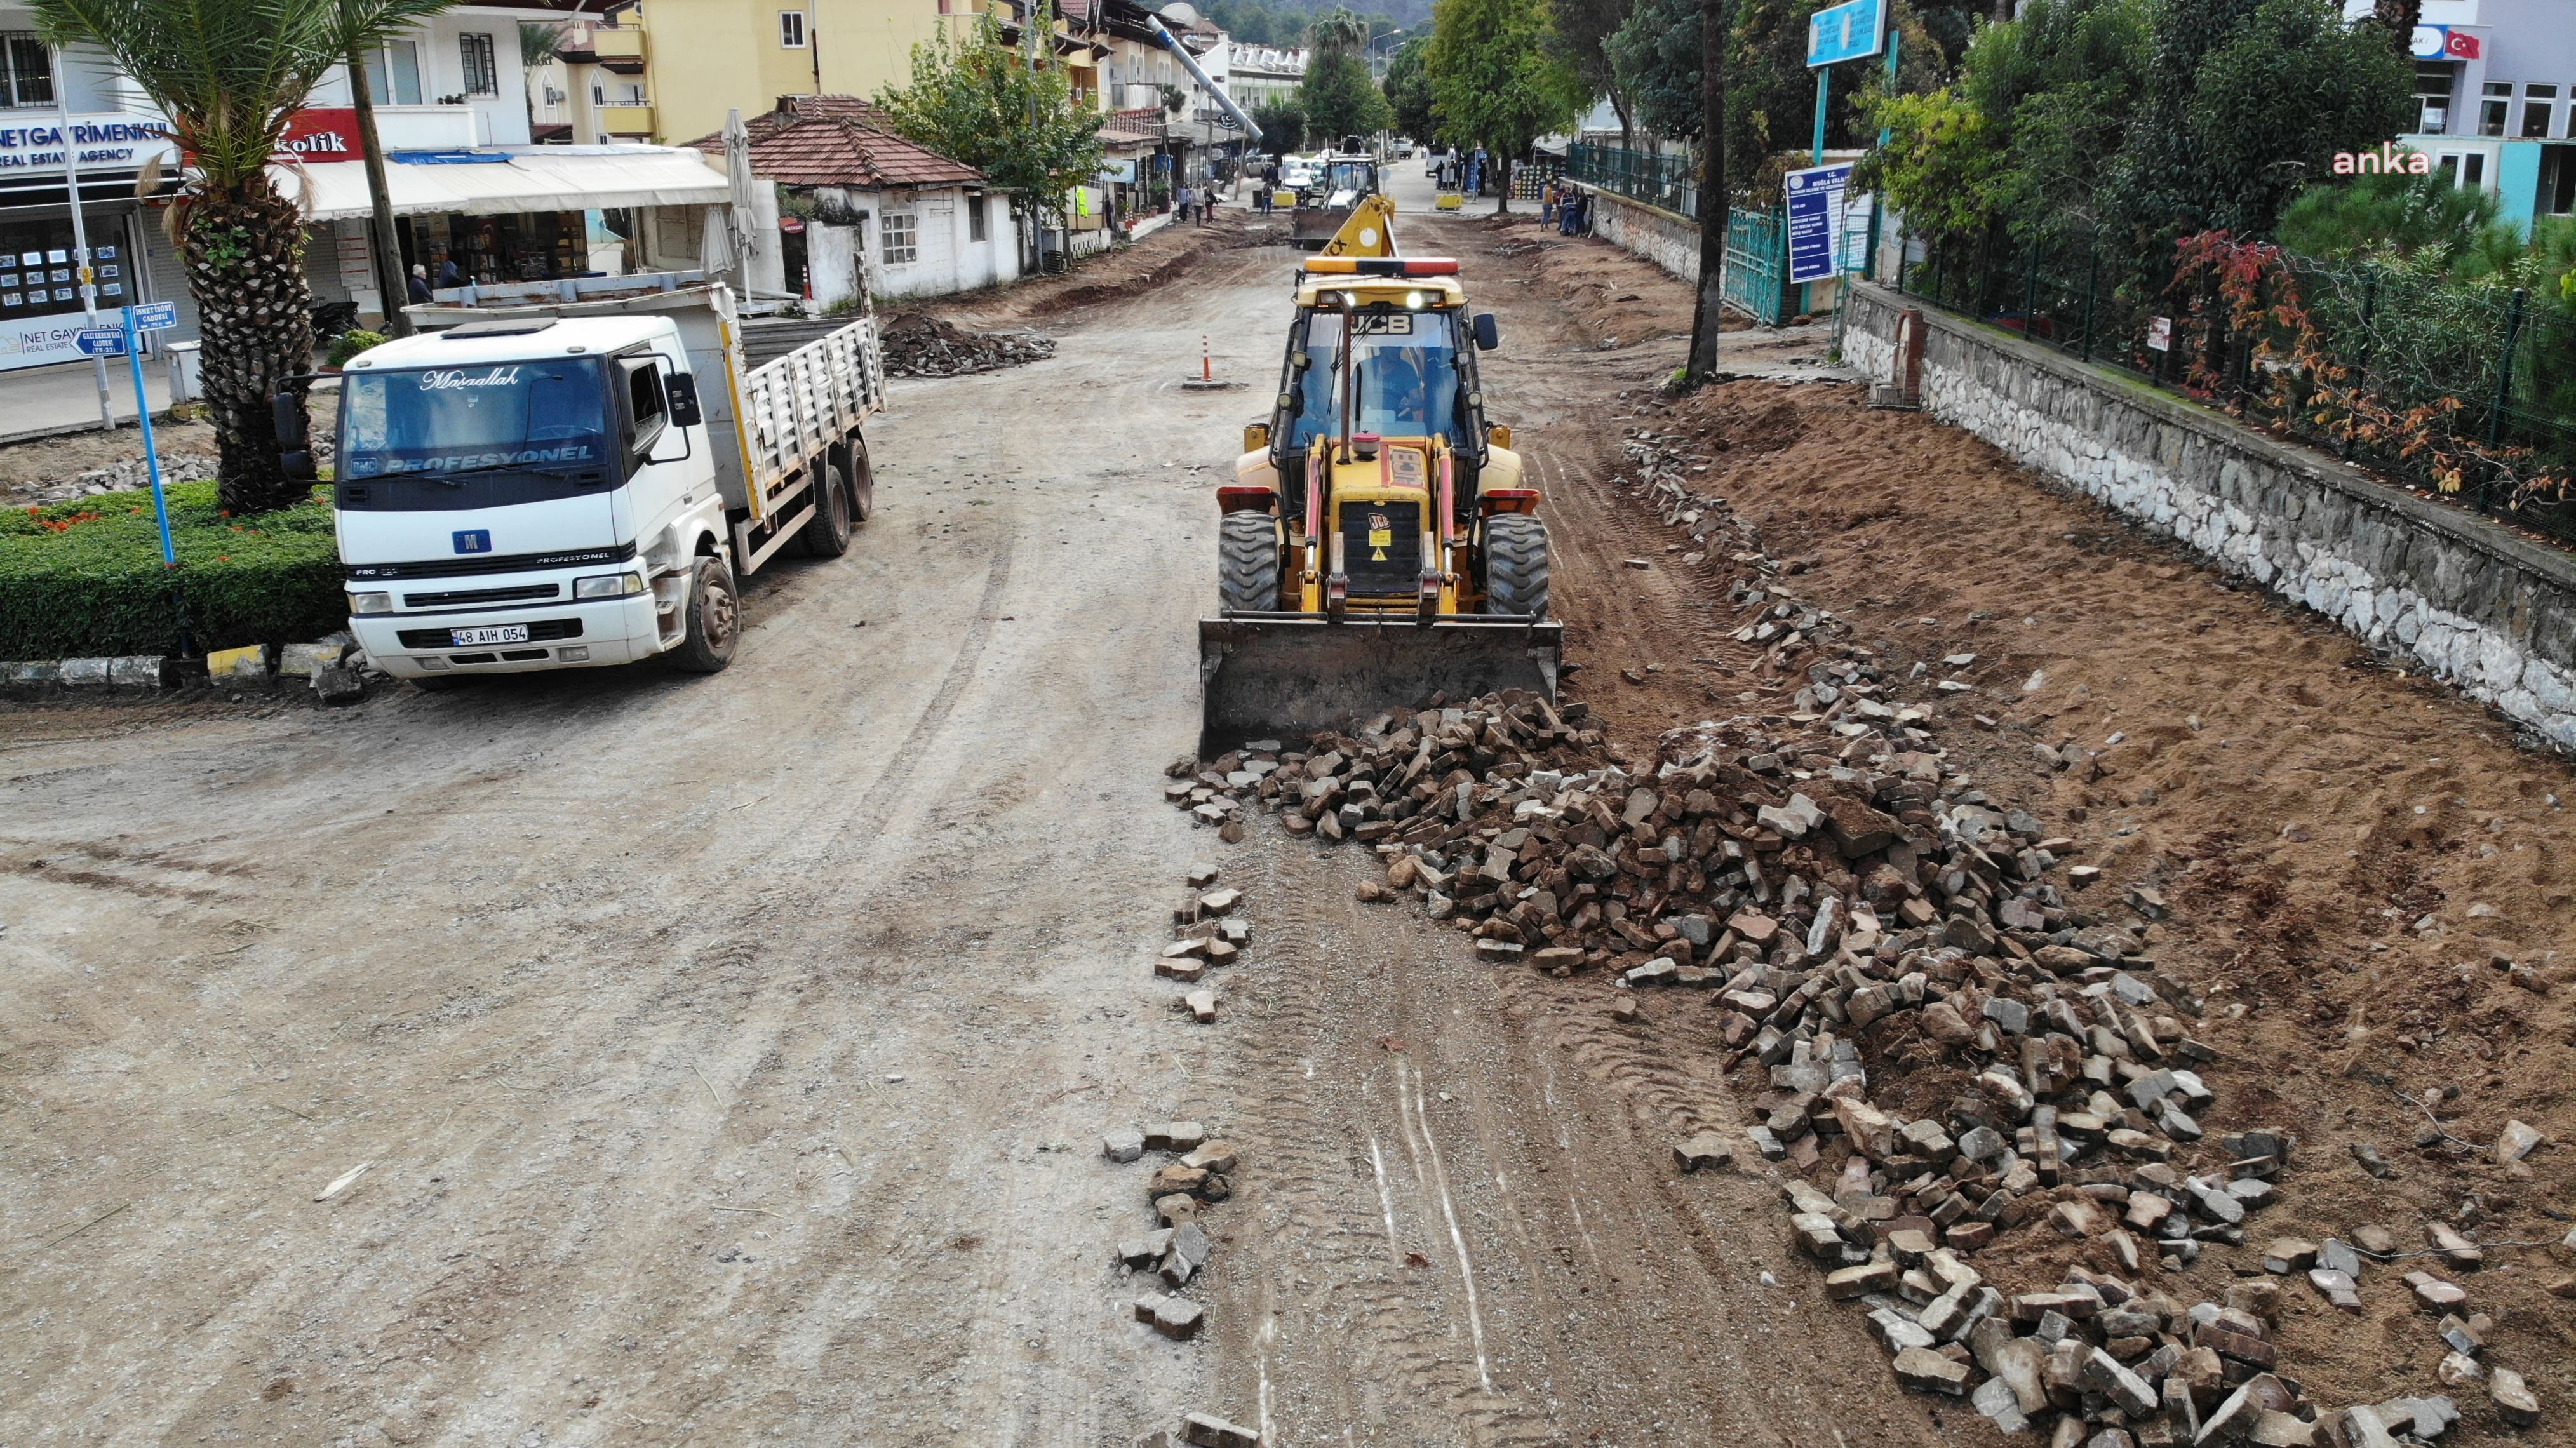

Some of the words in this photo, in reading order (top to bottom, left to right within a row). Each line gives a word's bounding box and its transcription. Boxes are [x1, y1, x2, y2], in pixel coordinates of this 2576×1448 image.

[79, 148, 133, 163] AGENCY
[1327, 237, 1348, 256] CX
[143, 311, 168, 322] CADDESİ
[25, 332, 46, 344] NET
[26, 345, 43, 353] REAL
[46, 342, 68, 351] ESTATE
[353, 460, 375, 472] BMC
[385, 446, 593, 473] PROFESYONEL
[1371, 515, 1389, 530] JCB
[537, 553, 610, 564] PROFESYONEL
[459, 631, 473, 643] 48
[479, 629, 499, 642] AIH
[503, 627, 526, 641] 054
